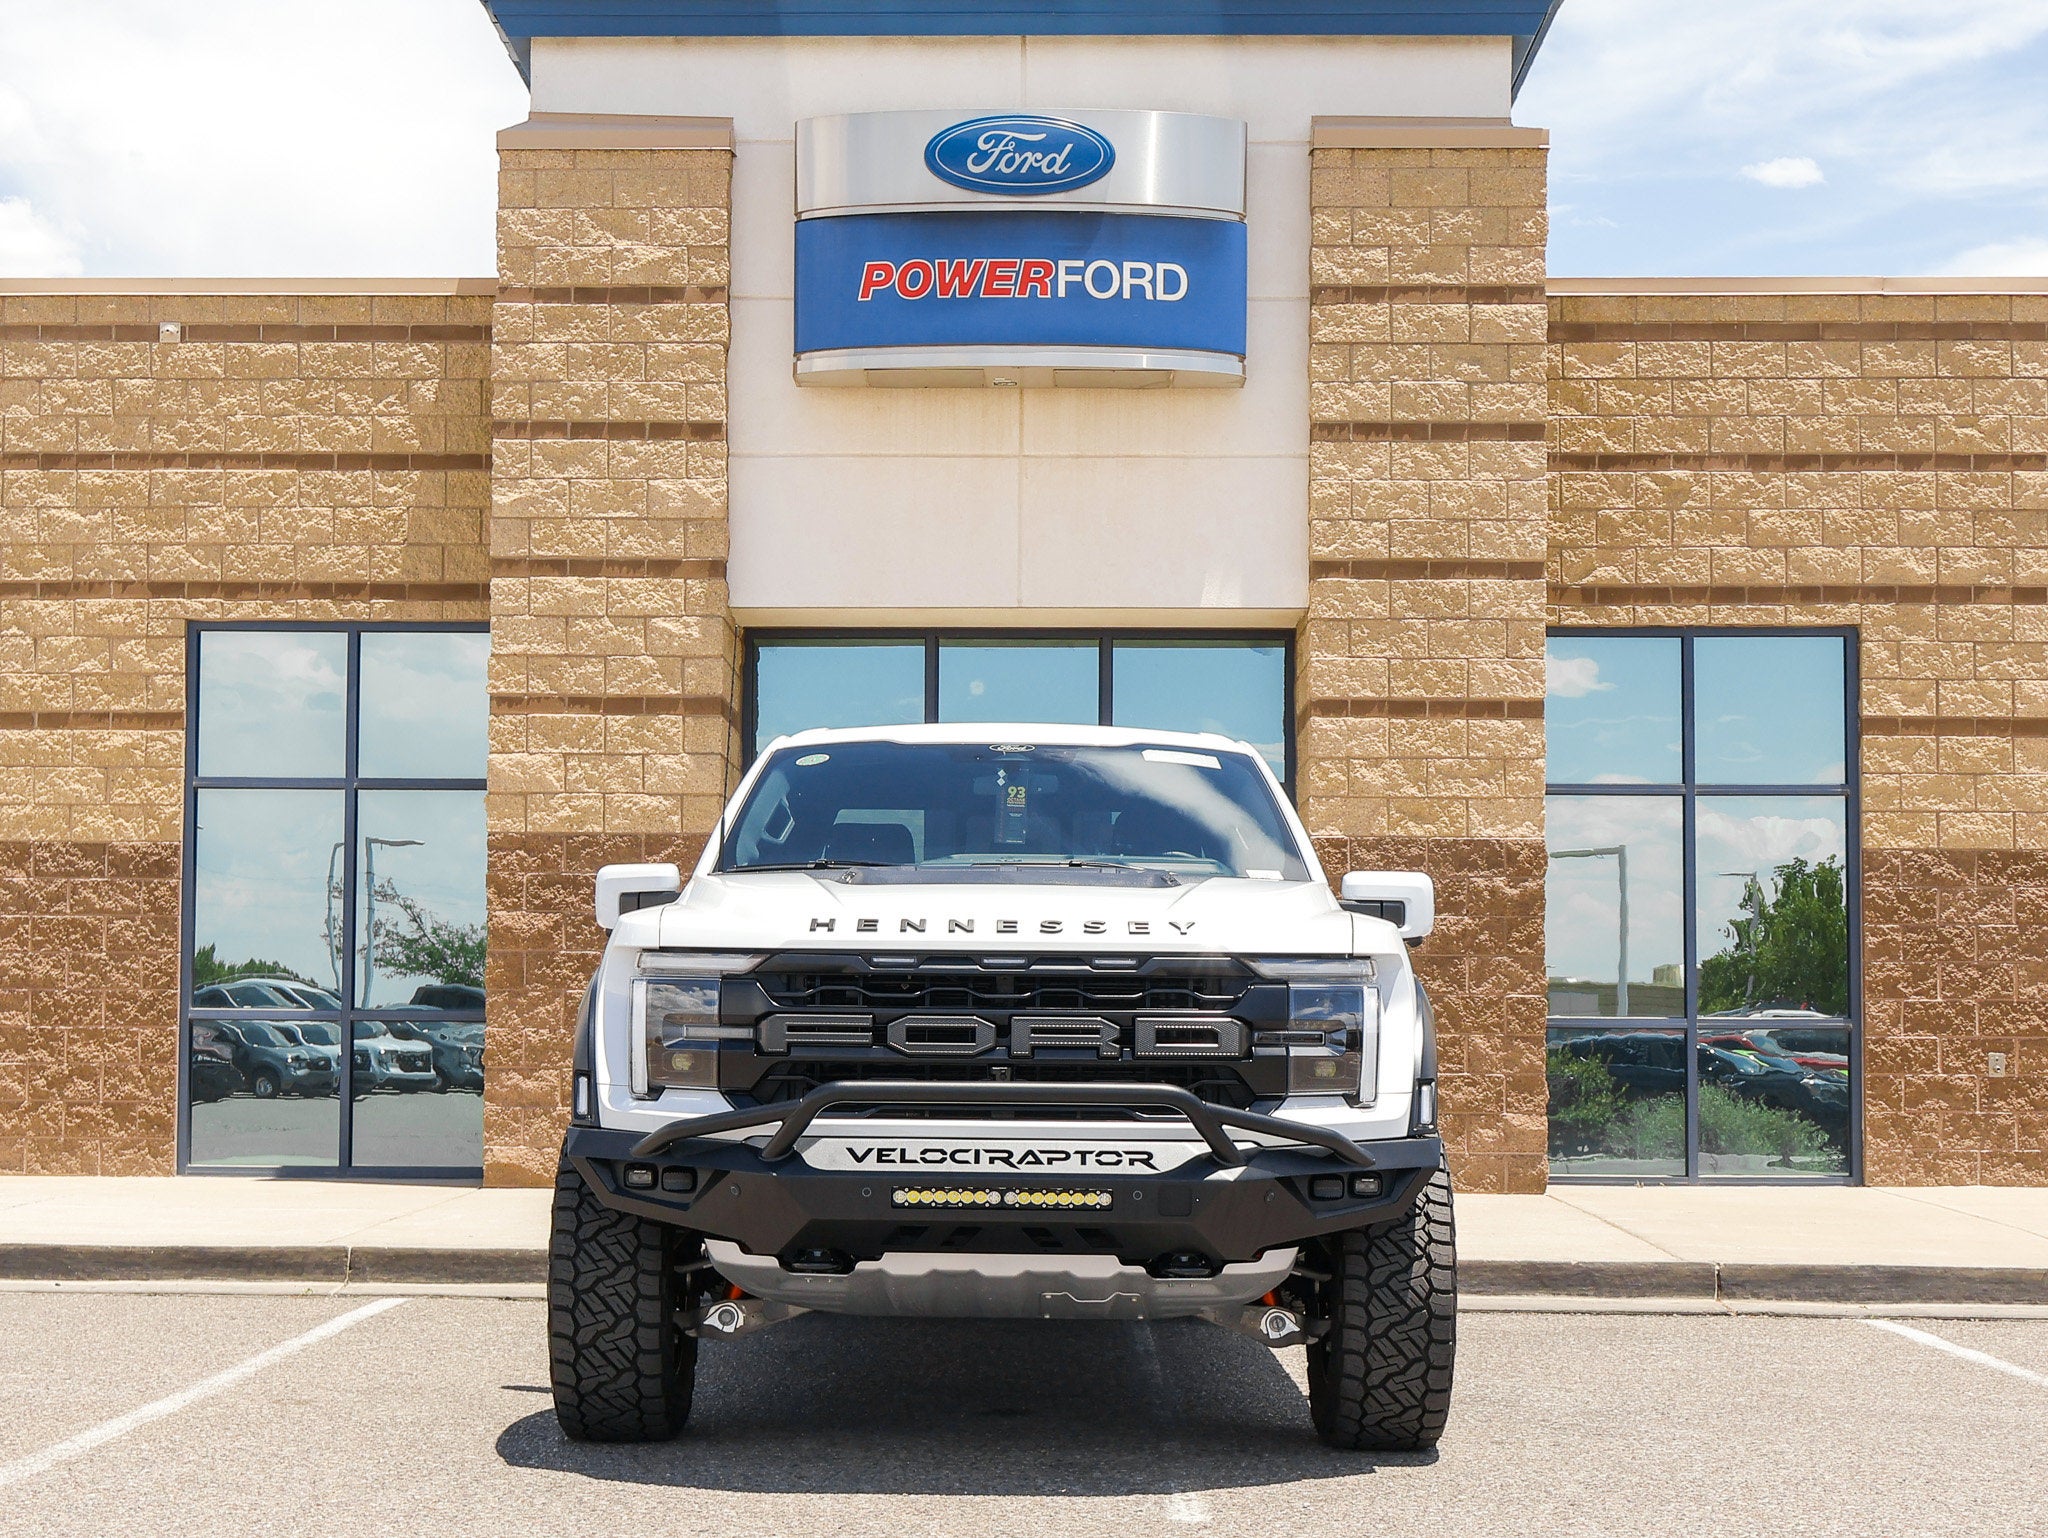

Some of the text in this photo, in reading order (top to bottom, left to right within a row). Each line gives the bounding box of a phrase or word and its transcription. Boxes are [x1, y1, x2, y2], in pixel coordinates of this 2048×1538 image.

[966, 130, 1074, 175] Ford
[1007, 786, 1026, 798] 93
[809, 917, 1197, 935] HENNESSEY
[758, 1014, 1250, 1058] FORD
[845, 1146, 1161, 1171] VELOCIRAPTOR
